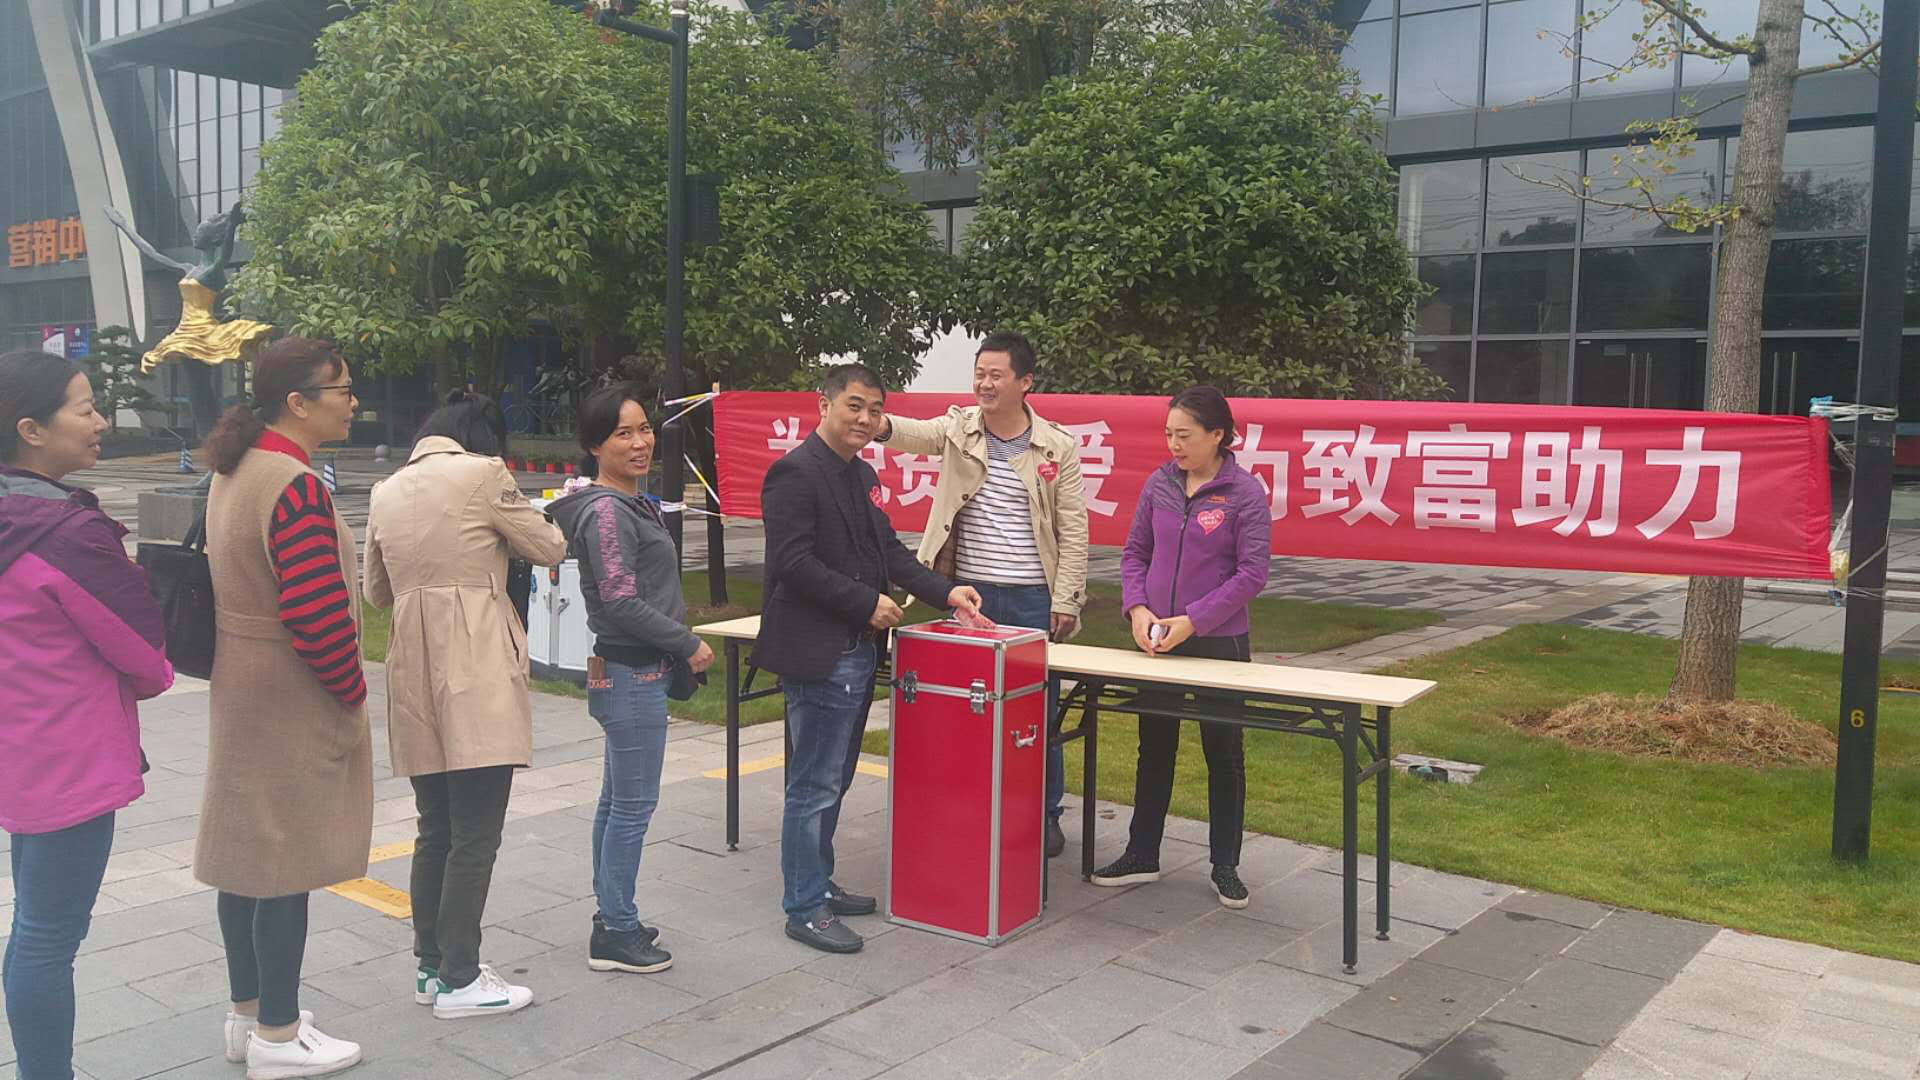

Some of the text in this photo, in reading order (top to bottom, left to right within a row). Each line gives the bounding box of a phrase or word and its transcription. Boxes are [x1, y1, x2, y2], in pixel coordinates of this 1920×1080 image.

[1232, 423, 1741, 540] 为致富助力
[1850, 709, 1865, 728] 6
